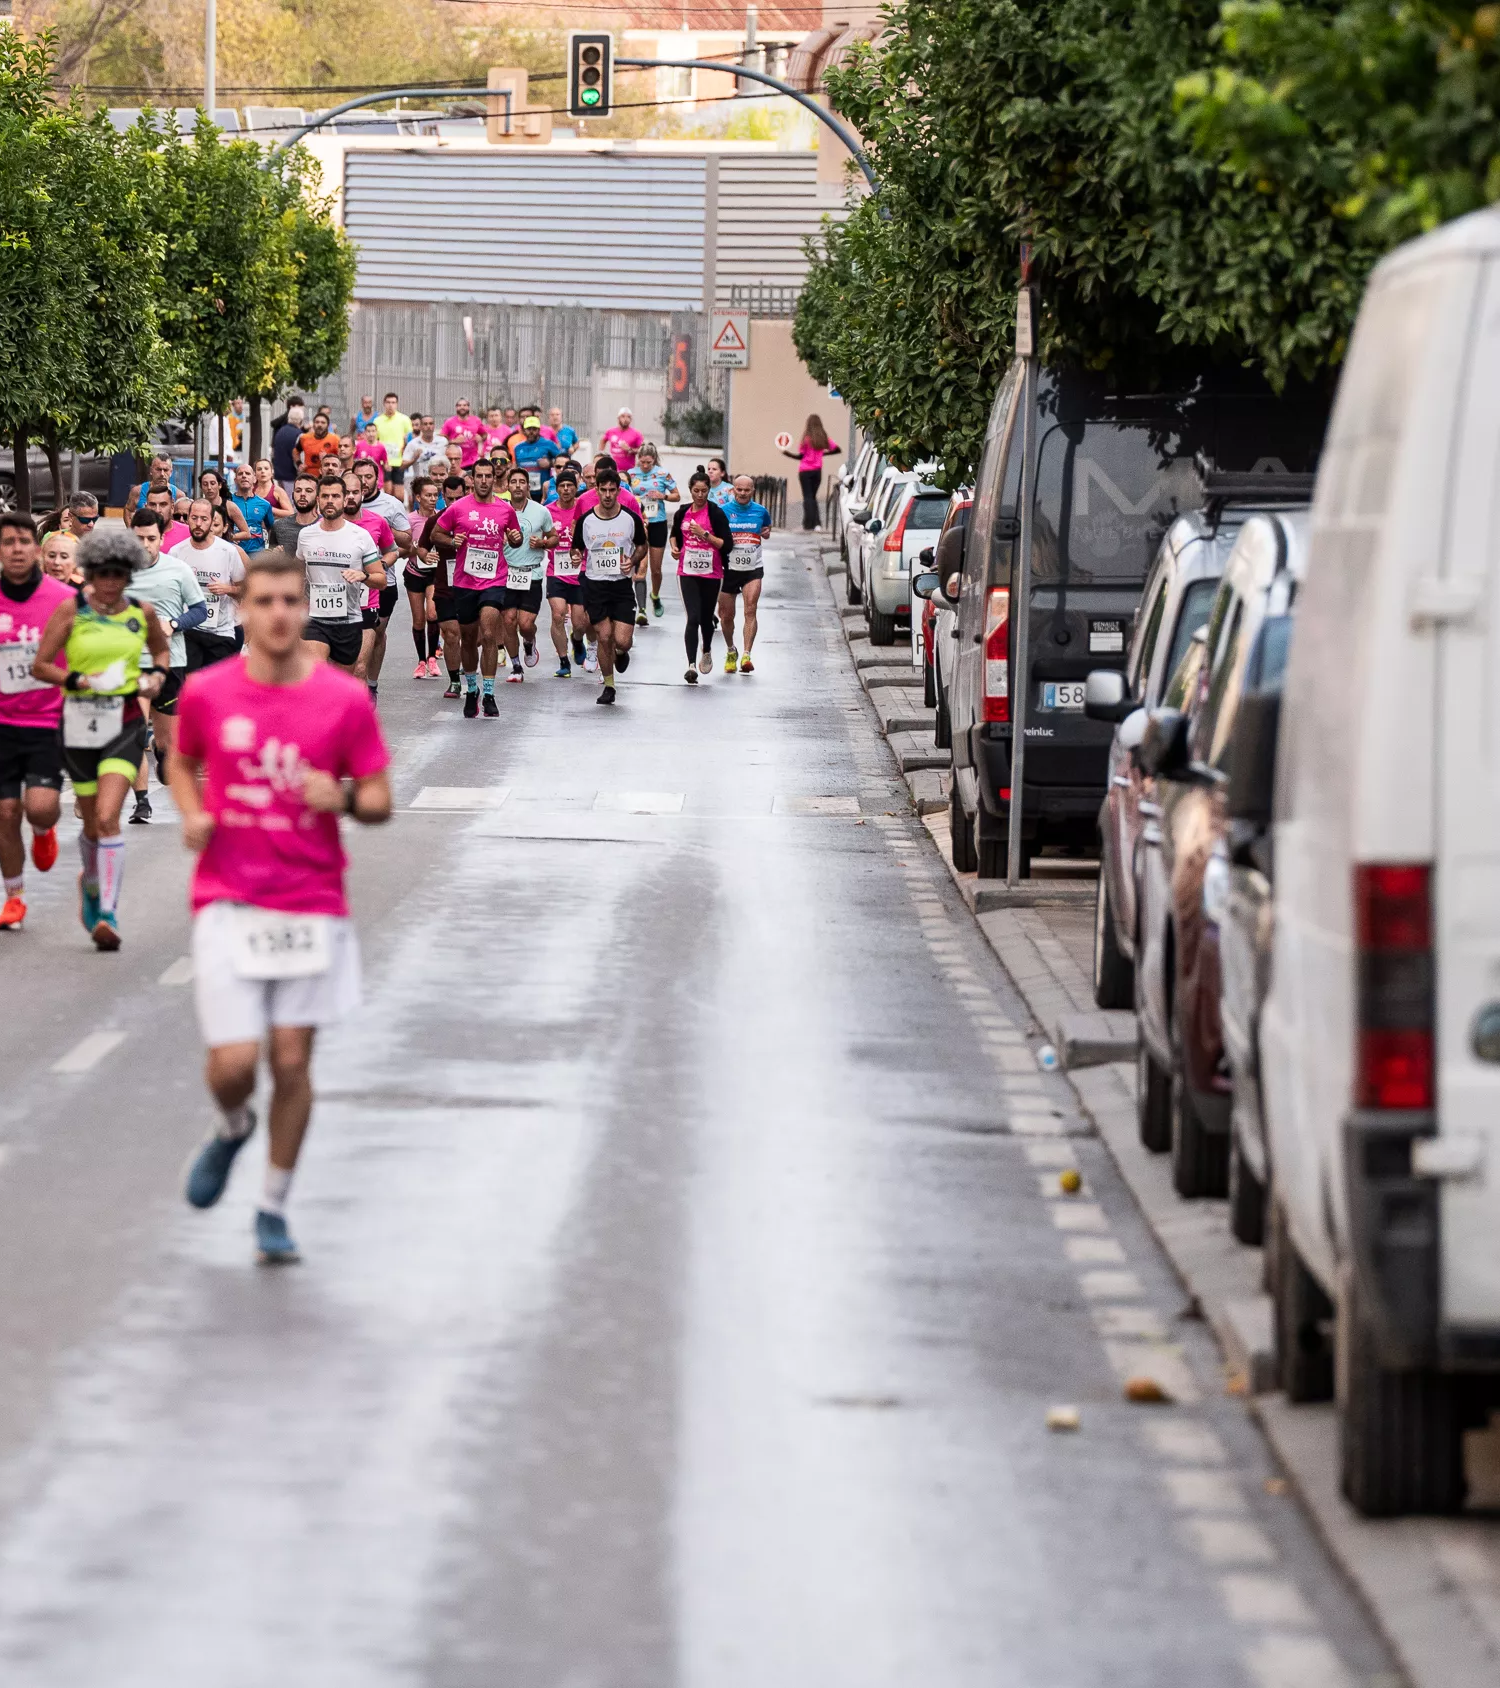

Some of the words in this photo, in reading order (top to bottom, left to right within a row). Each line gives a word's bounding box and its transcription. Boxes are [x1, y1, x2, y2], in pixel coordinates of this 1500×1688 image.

[559, 561, 575, 570] 131
[596, 559, 617, 568] 1409
[687, 560, 710, 569] 1323
[735, 556, 752, 565] 999
[469, 560, 494, 572] 1348
[507, 573, 529, 584] 1025
[315, 597, 343, 609] 1015
[87, 718, 98, 733] 4
